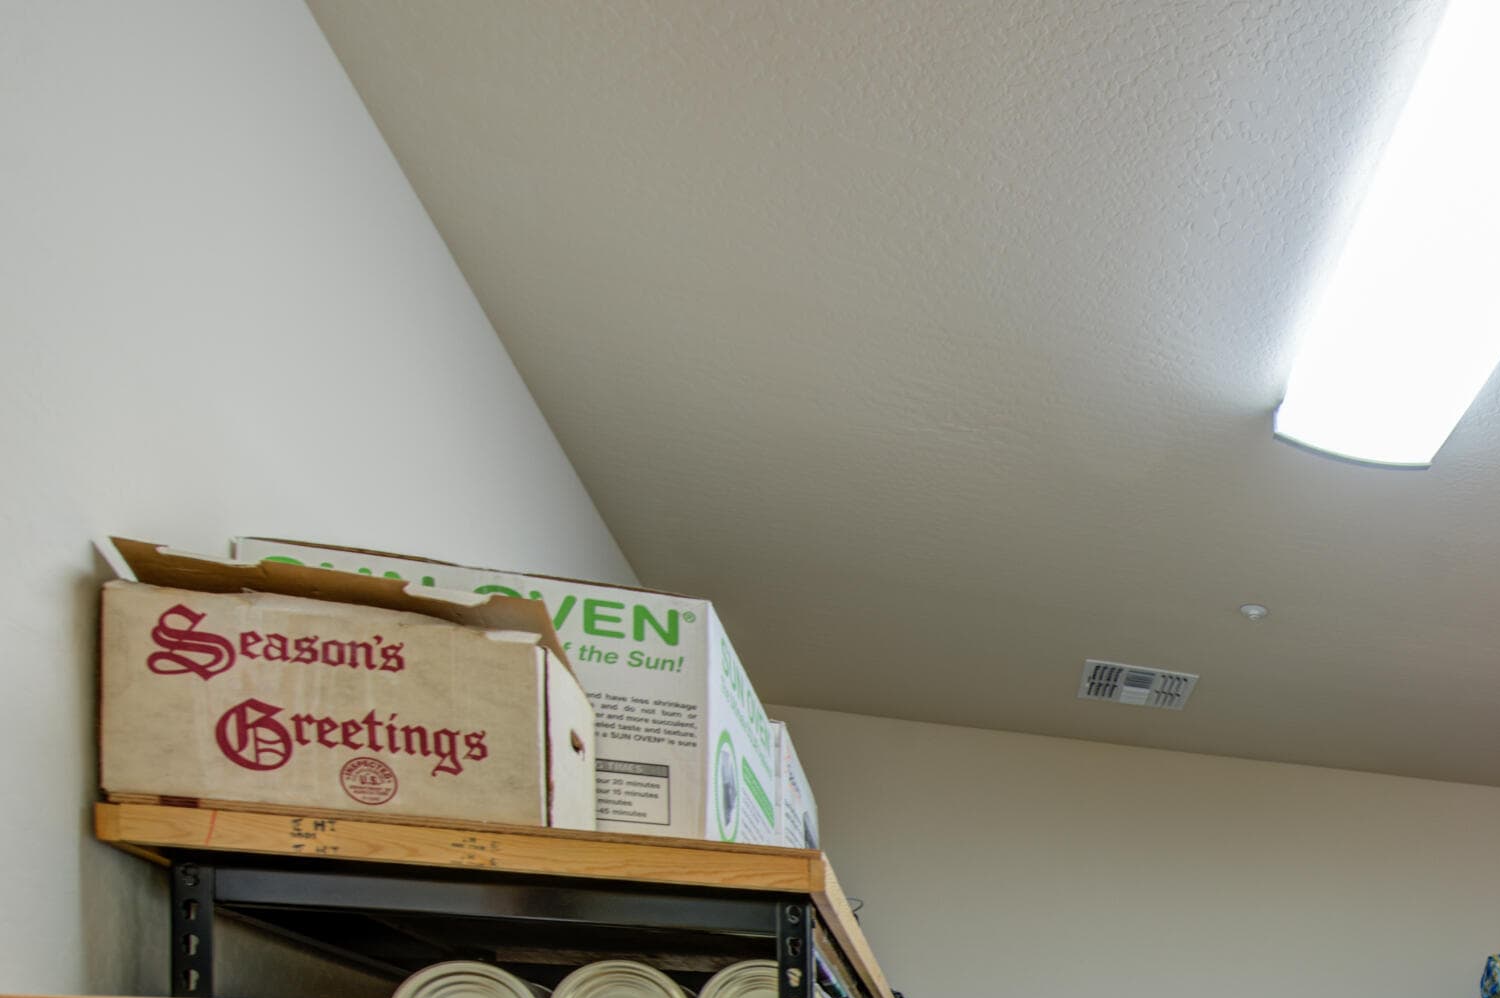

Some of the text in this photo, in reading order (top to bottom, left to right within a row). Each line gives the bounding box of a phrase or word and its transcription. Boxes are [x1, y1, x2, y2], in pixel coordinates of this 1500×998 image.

[147, 604, 405, 681] Season's
[578, 642, 684, 673] the Sun!
[215, 698, 488, 777] Greetings
